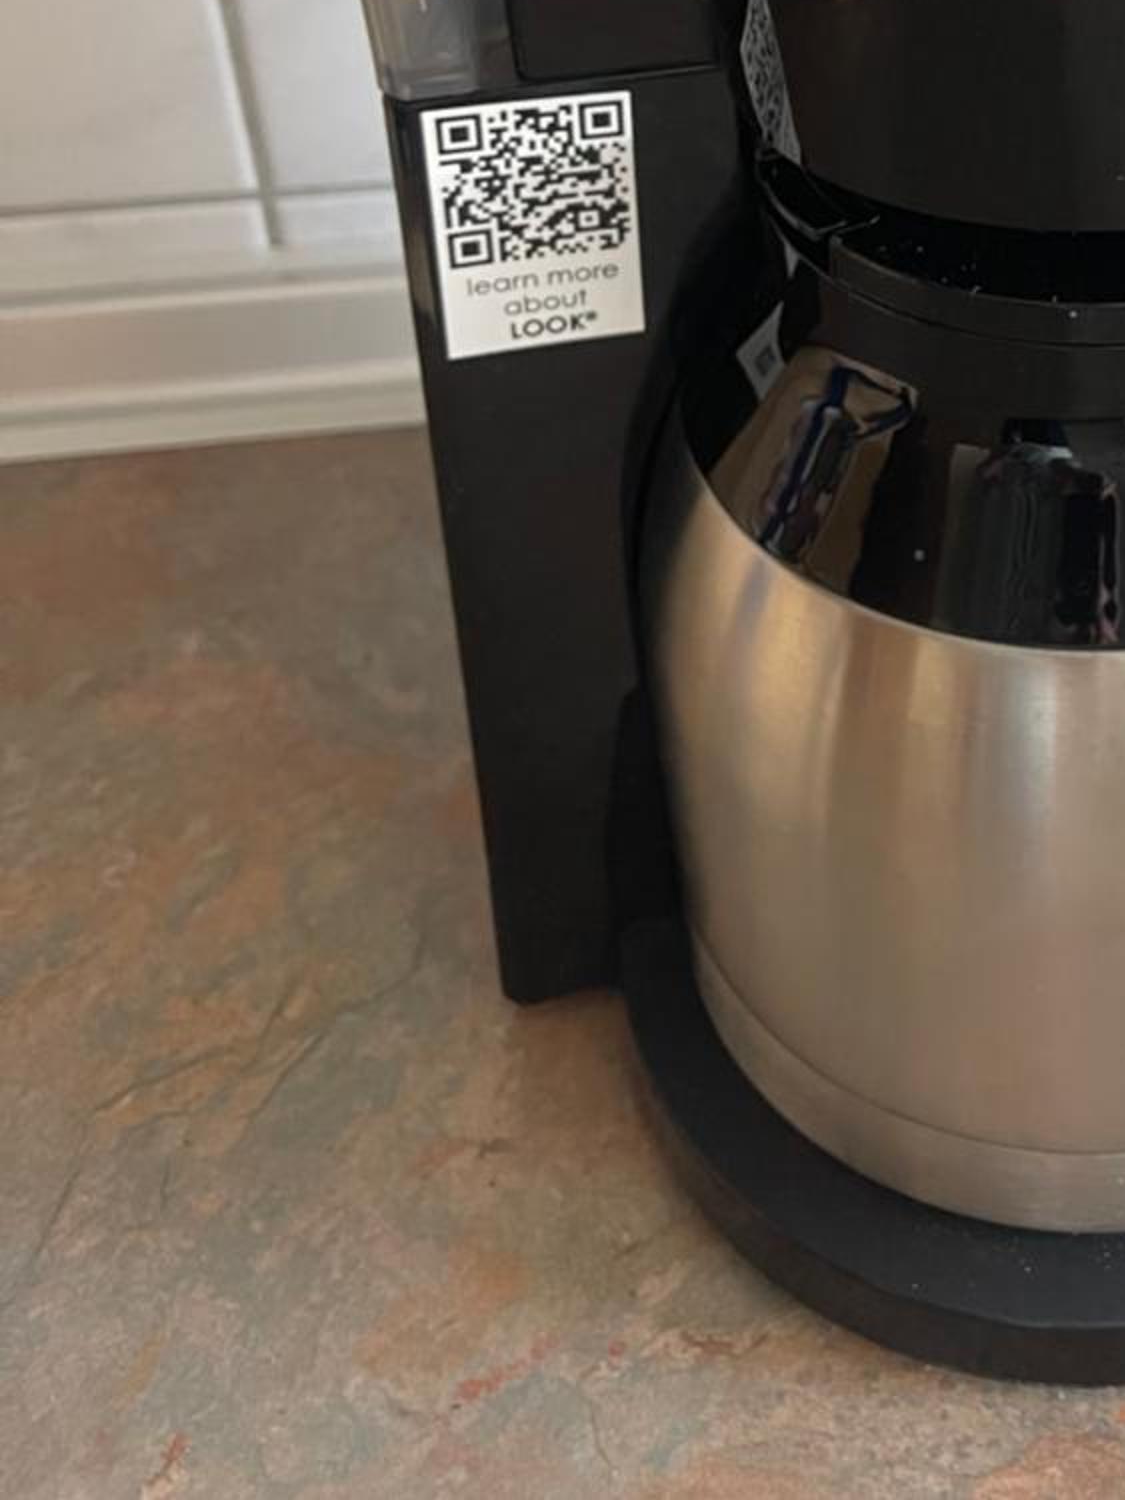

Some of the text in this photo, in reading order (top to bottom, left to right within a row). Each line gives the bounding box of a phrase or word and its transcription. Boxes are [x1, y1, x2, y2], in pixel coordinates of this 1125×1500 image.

[467, 264, 619, 296] learn more
[504, 290, 586, 316] about
